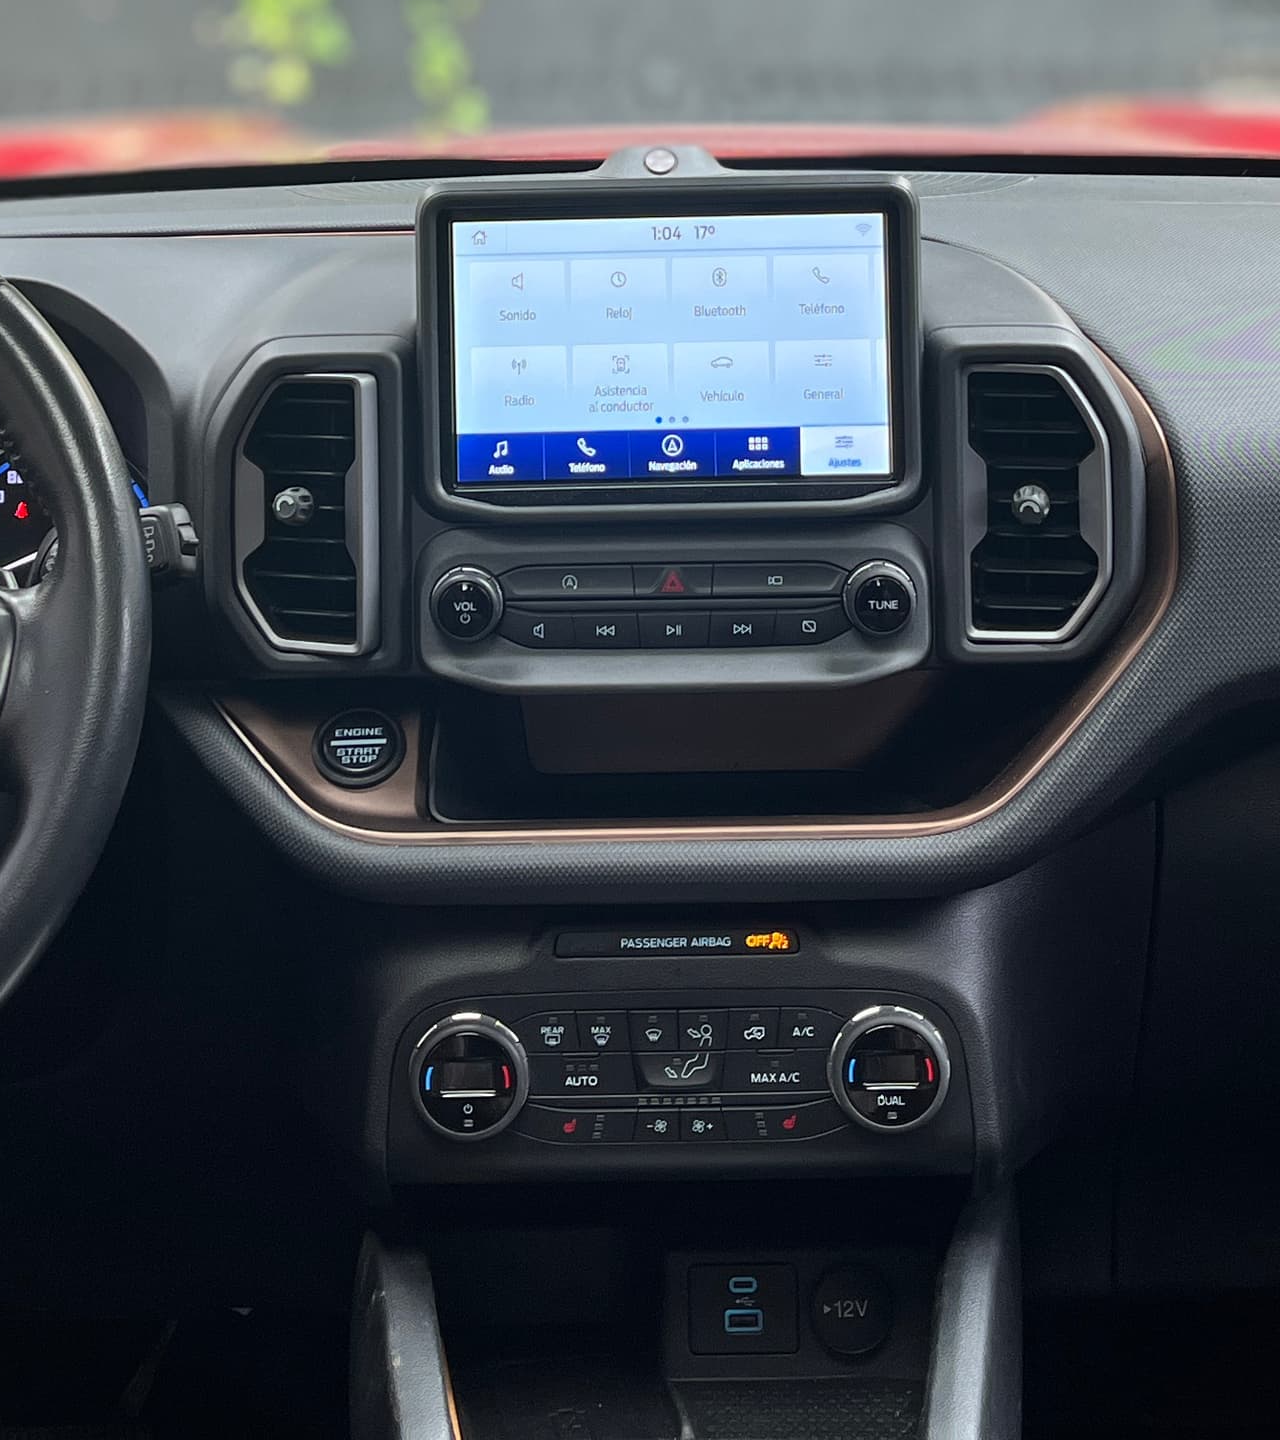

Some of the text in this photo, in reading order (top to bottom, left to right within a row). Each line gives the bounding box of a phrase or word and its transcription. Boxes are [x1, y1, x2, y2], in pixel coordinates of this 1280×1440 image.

[652, 226, 681, 241] 1:04
[606, 307, 632, 321] Reloj
[694, 304, 746, 316] Bluetooth
[799, 302, 844, 315] Teléfono
[499, 309, 536, 321] Sonido
[594, 384, 647, 397] Asistencia
[803, 388, 843, 401] General
[504, 394, 534, 407] Radio
[589, 400, 653, 413] al conductor
[569, 461, 605, 473] Teléfono
[649, 459, 697, 473] Navegación
[733, 458, 784, 470] Aplicaciones
[828, 457, 861, 469] Ajustes
[489, 464, 514, 475] Audio
[453, 601, 477, 611] VOL
[868, 600, 899, 610] TUNE
[335, 727, 384, 737] ENGINE
[336, 747, 382, 756] START
[341, 755, 377, 764] STOP
[620, 935, 769, 949] PASSENGER AIRBAG OFF
[540, 1026, 564, 1034] REAR
[591, 1026, 611, 1034] MAX
[792, 1026, 814, 1037] A/C
[565, 1076, 598, 1086] AUTO
[751, 1072, 800, 1083] MAX A/C
[877, 1095, 905, 1106] DUAL
[832, 1300, 869, 1318] 12V
